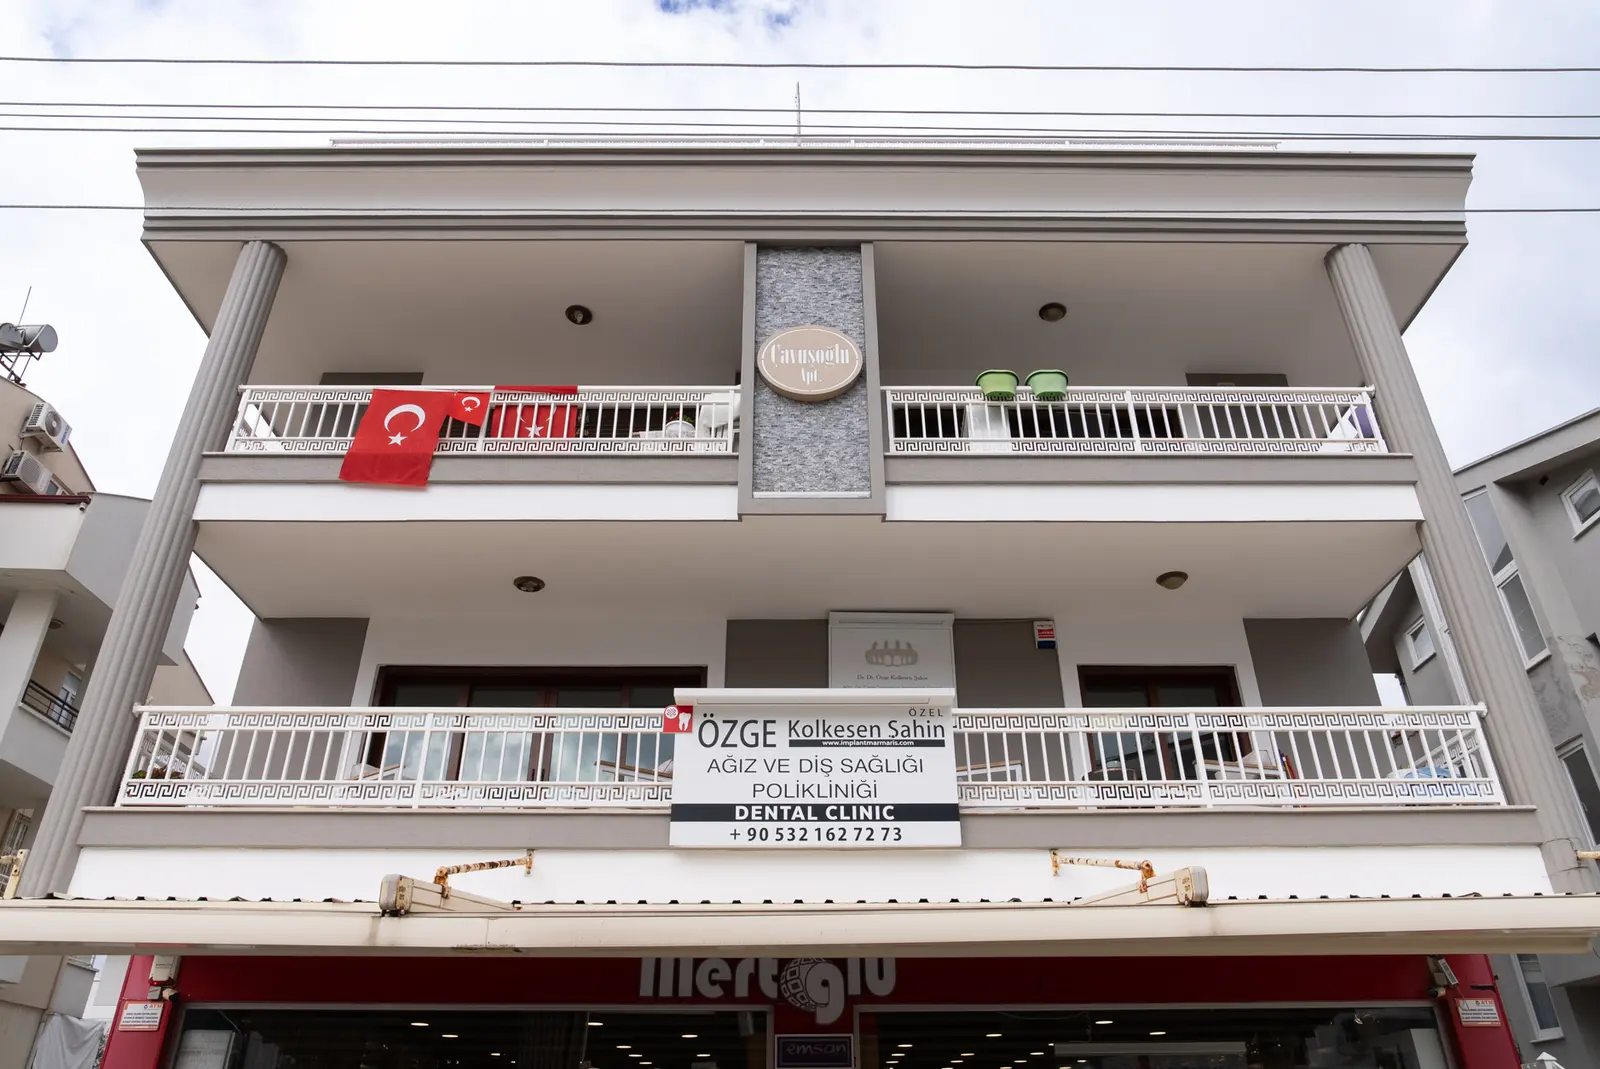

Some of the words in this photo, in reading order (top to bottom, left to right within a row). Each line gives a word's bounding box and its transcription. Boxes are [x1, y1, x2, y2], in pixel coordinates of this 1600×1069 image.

[908, 706, 944, 717] ÖZEL
[697, 712, 776, 748] ÖZGE
[788, 718, 881, 738] Kolkesen
[888, 718, 945, 739] Şahin
[822, 740, 915, 748] www.implantmarmaris.com
[706, 754, 757, 774] AĞIZ
[763, 758, 790, 774] VE
[799, 755, 834, 777] DİŞ
[840, 754, 924, 774] SAĞLIĞI
[752, 780, 878, 799] POLİKLİNİĞİ
[735, 805, 818, 821] DENTAL
[825, 805, 895, 821] CLINIC
[747, 827, 769, 841] 90
[775, 827, 809, 841] 532
[815, 827, 848, 841] 162
[853, 827, 875, 841] 72
[881, 827, 903, 841] 73
[785, 1043, 847, 1055] emsan
